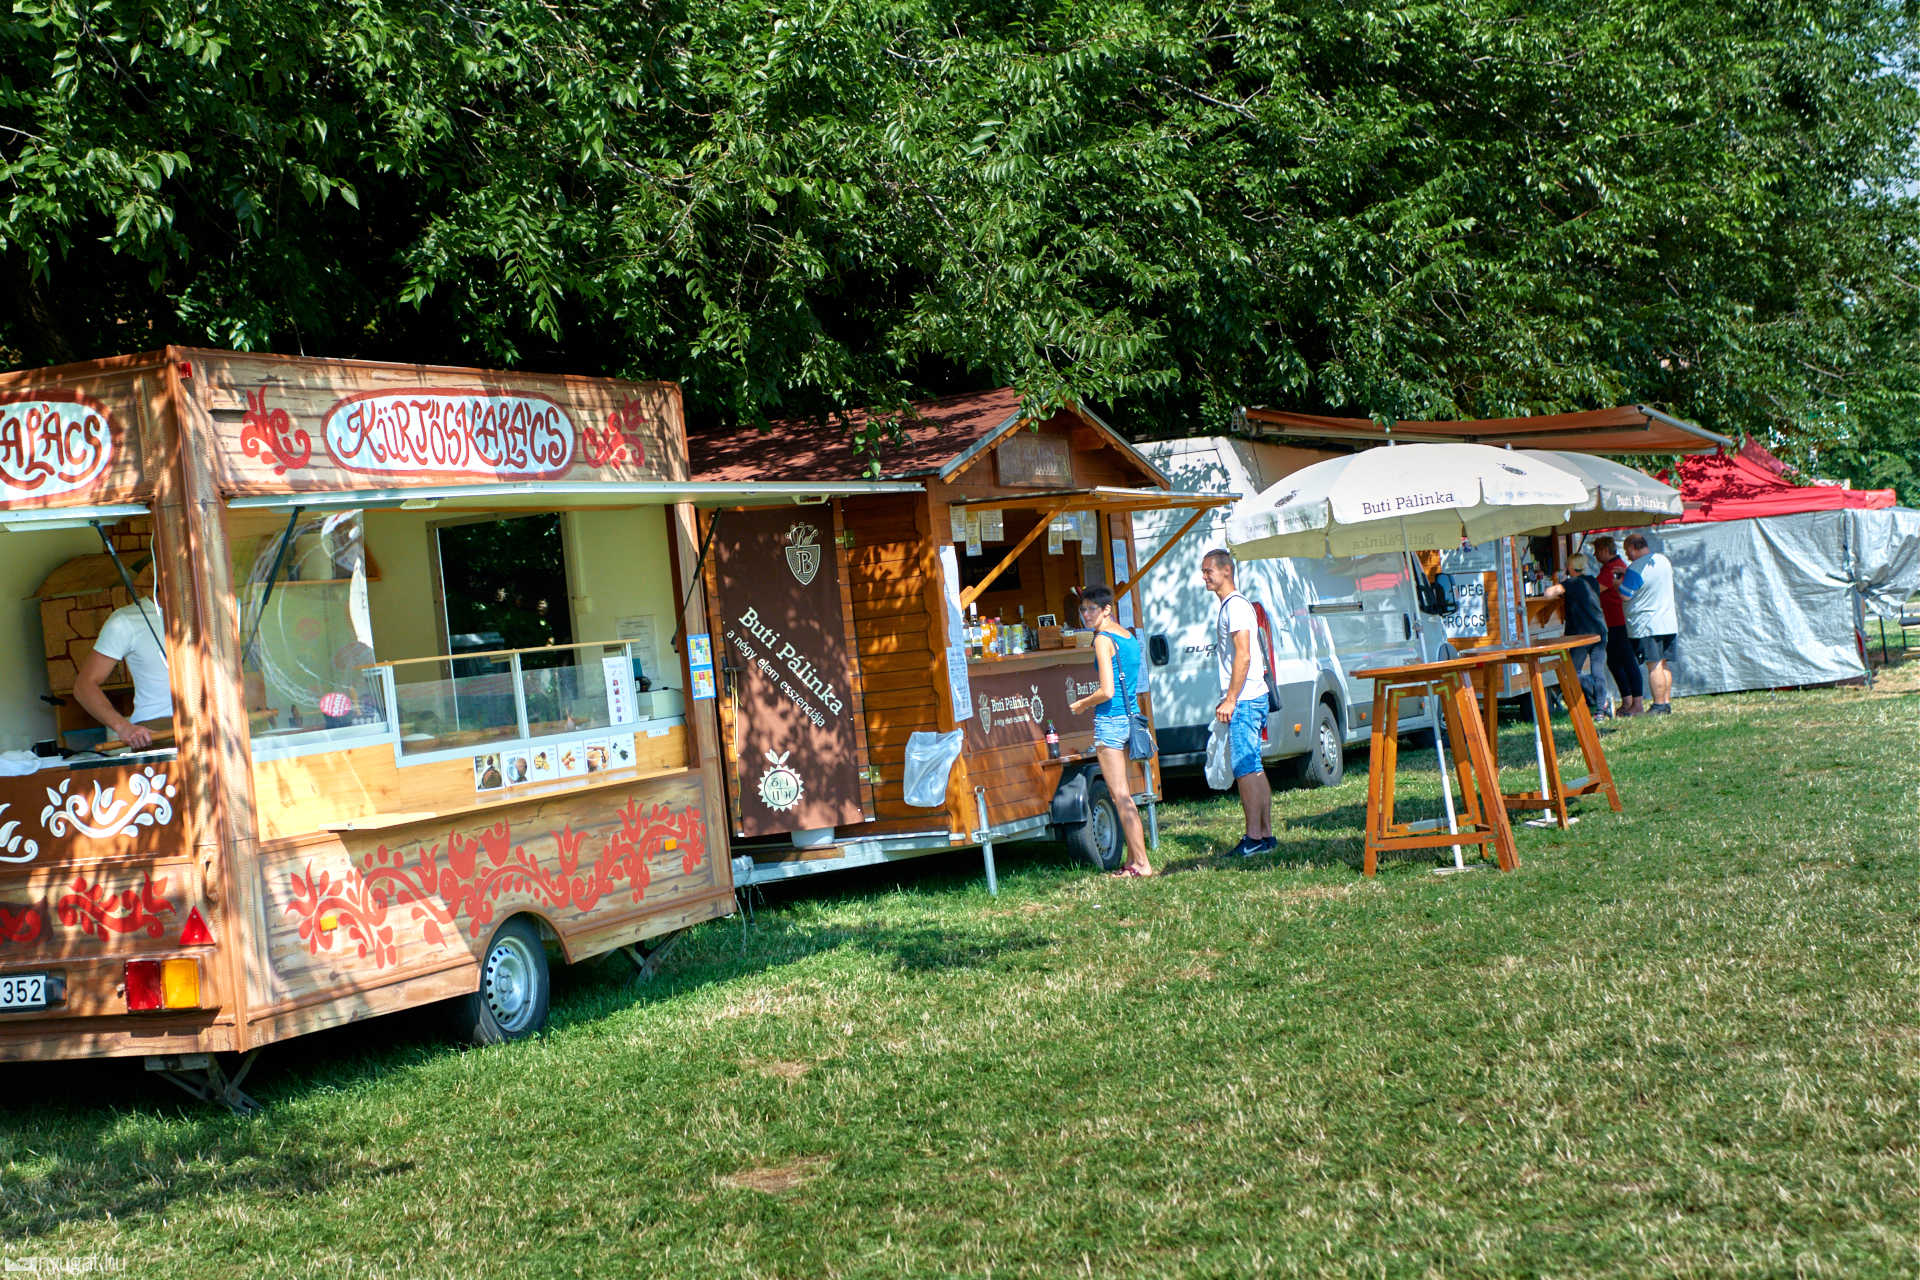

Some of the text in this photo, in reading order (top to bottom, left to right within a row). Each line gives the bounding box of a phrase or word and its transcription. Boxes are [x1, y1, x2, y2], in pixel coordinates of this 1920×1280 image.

[1363, 491, 1455, 515] Buti Pálinka
[1455, 583, 1484, 597] IDEG
[726, 629, 825, 727] a négy elem esszenciája
[739, 606, 780, 649] Buti
[776, 642, 844, 716] Pálinka
